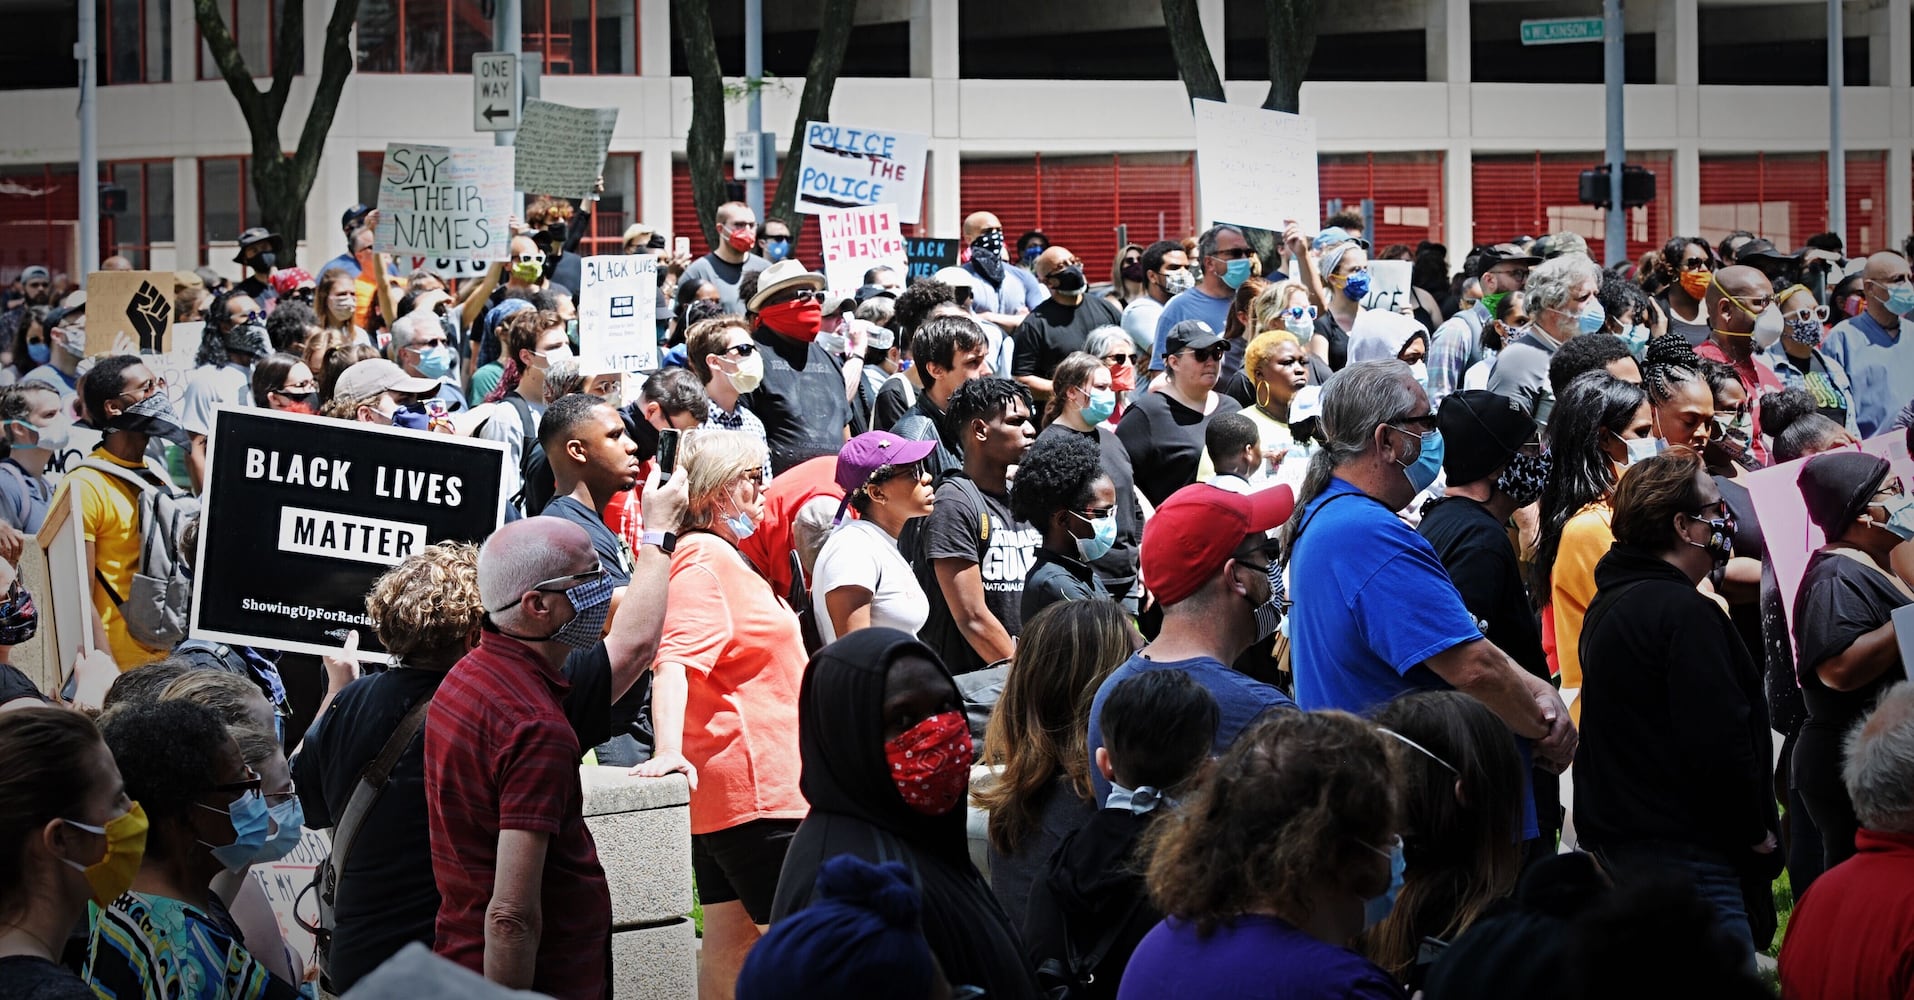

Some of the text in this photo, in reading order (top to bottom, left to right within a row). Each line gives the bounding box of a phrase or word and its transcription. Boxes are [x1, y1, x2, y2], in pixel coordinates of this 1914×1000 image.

[481, 61, 509, 78] ONE
[481, 82, 510, 98] WAY
[809, 124, 896, 158] POLICE
[387, 148, 449, 185] SAY
[867, 155, 907, 182] THE
[401, 184, 484, 213] THEIR
[801, 166, 883, 202] POLICE
[393, 213, 491, 250] NAMES
[824, 209, 890, 239] WHITE
[906, 240, 946, 258] LACK
[907, 262, 940, 279] IVES
[605, 351, 651, 370] MATTER
[245, 447, 463, 507] BLACK LIVES
[293, 515, 415, 558] MATTER
